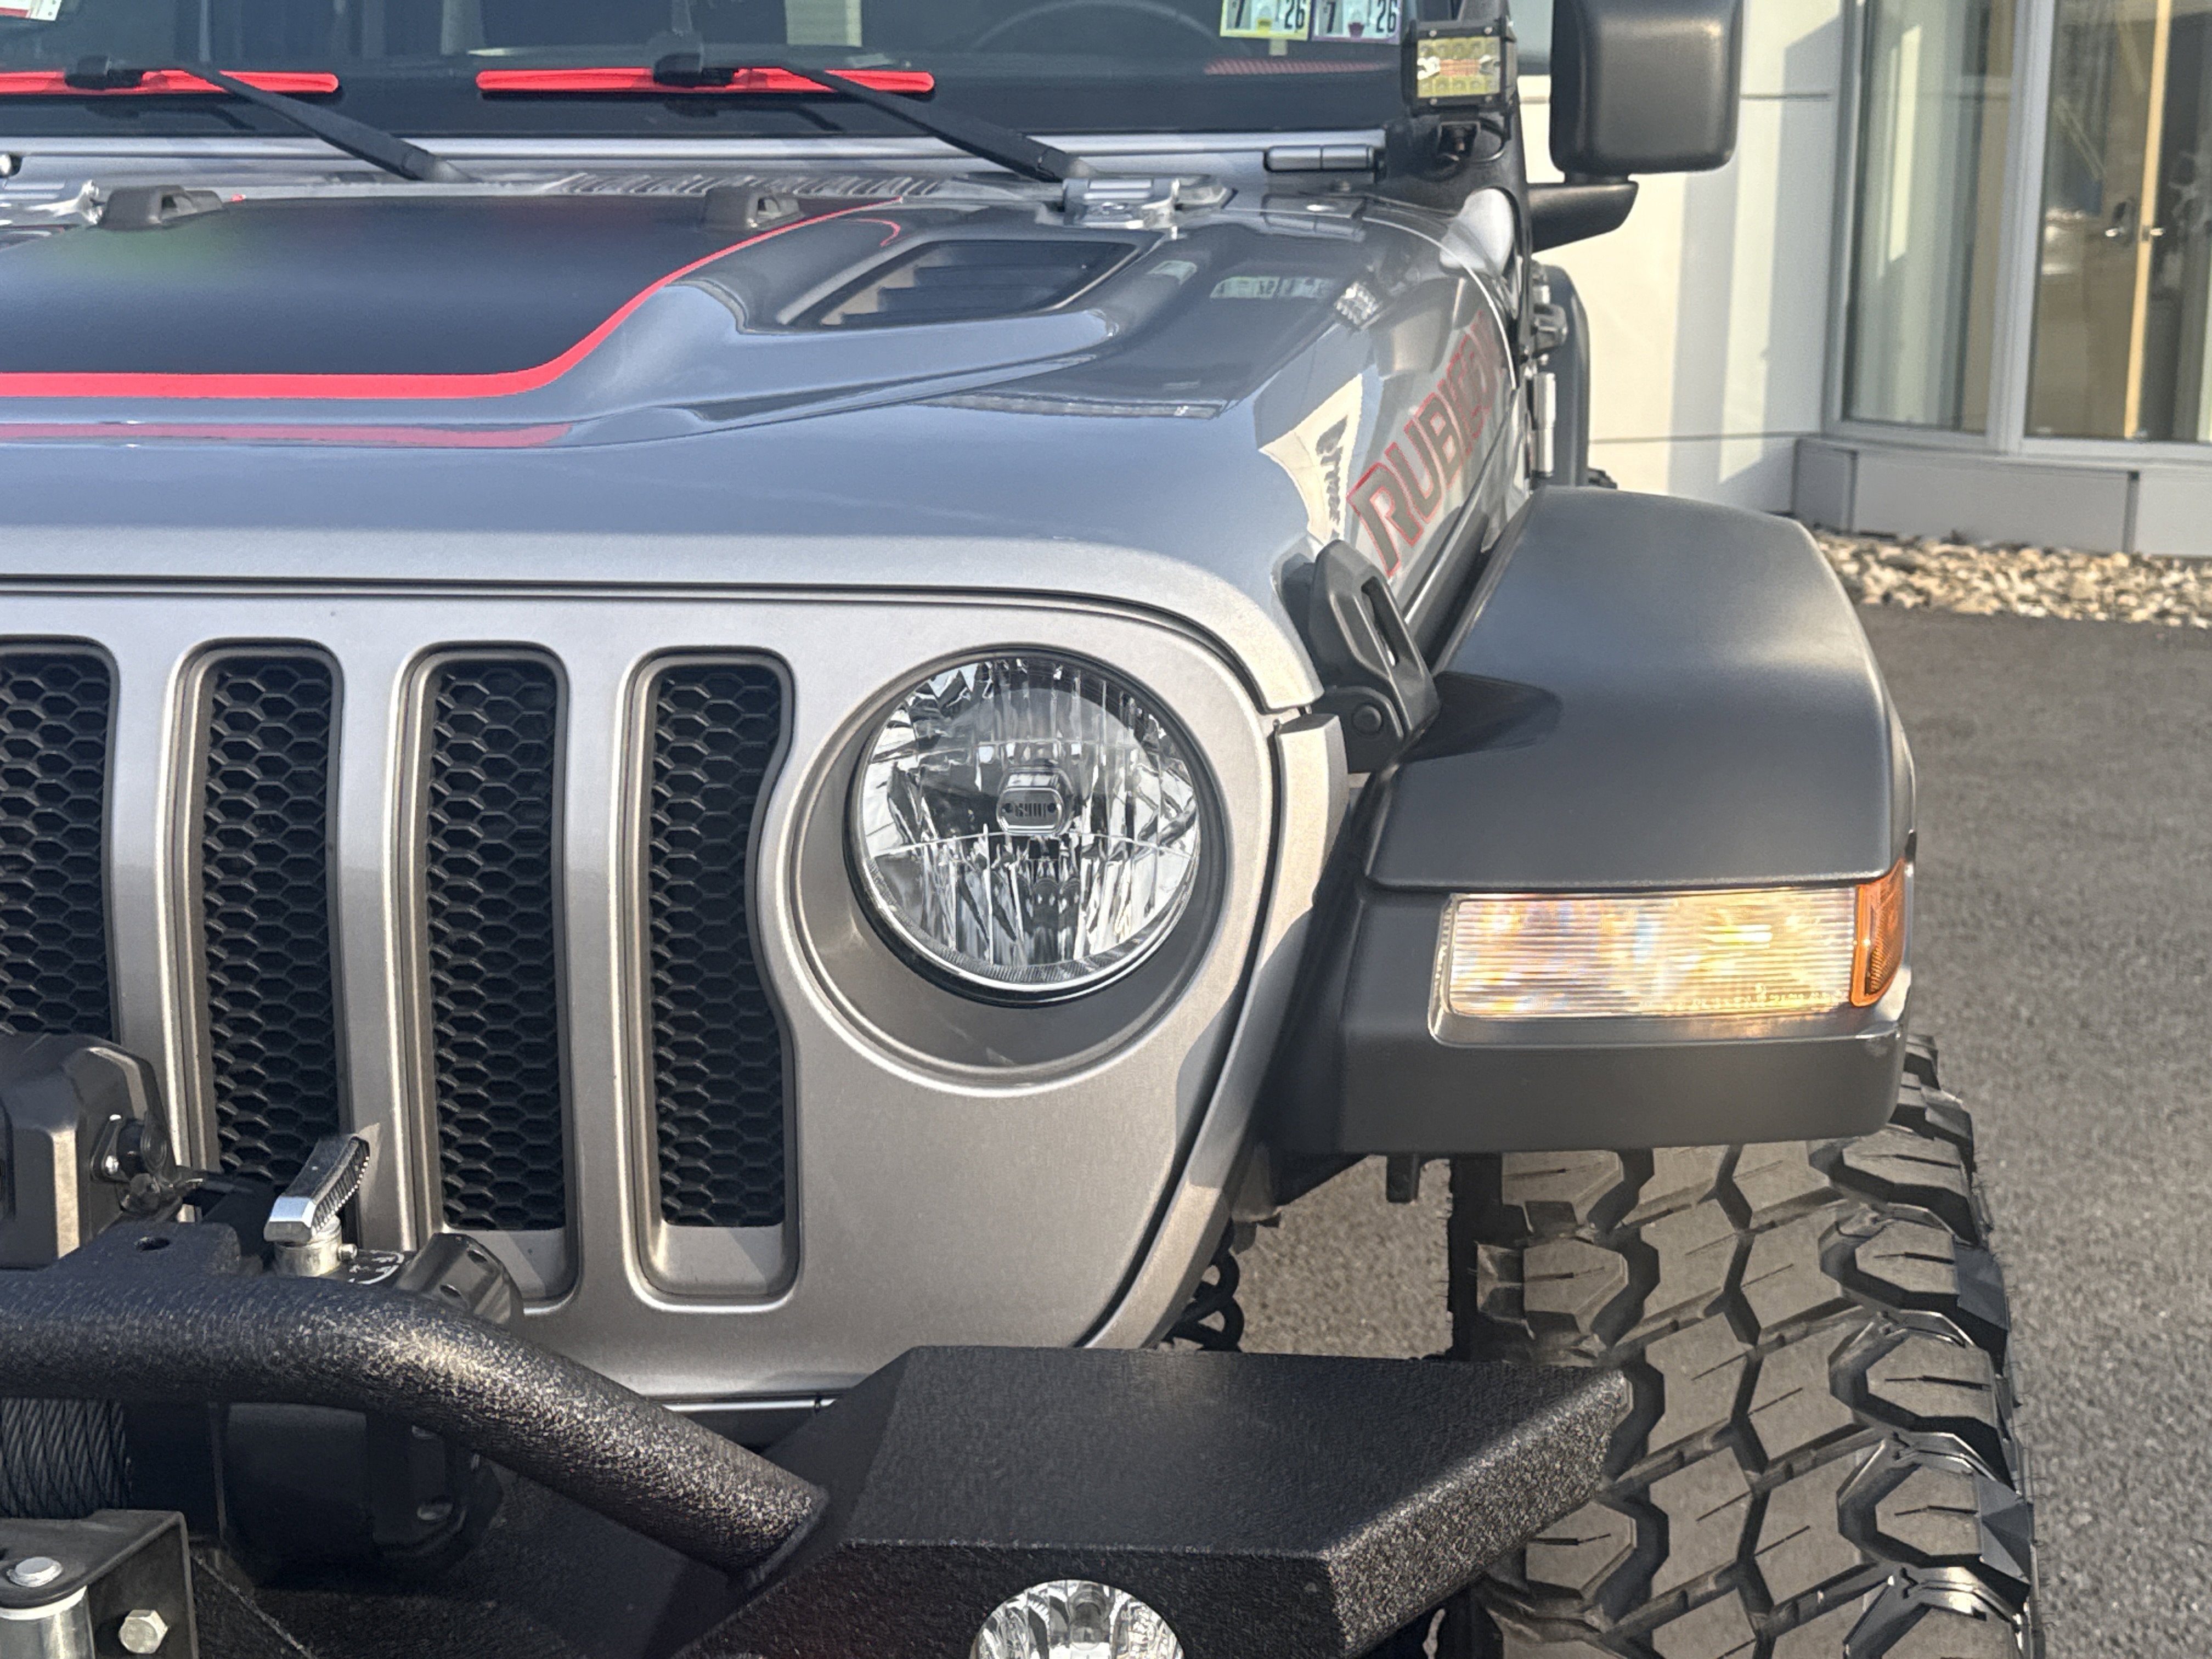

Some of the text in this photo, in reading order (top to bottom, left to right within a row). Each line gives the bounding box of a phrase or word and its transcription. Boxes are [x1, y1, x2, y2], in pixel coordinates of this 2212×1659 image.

[1284, 0, 1306, 29] 26
[1326, 1, 1336, 33] 7
[1376, 0, 1398, 33] 26
